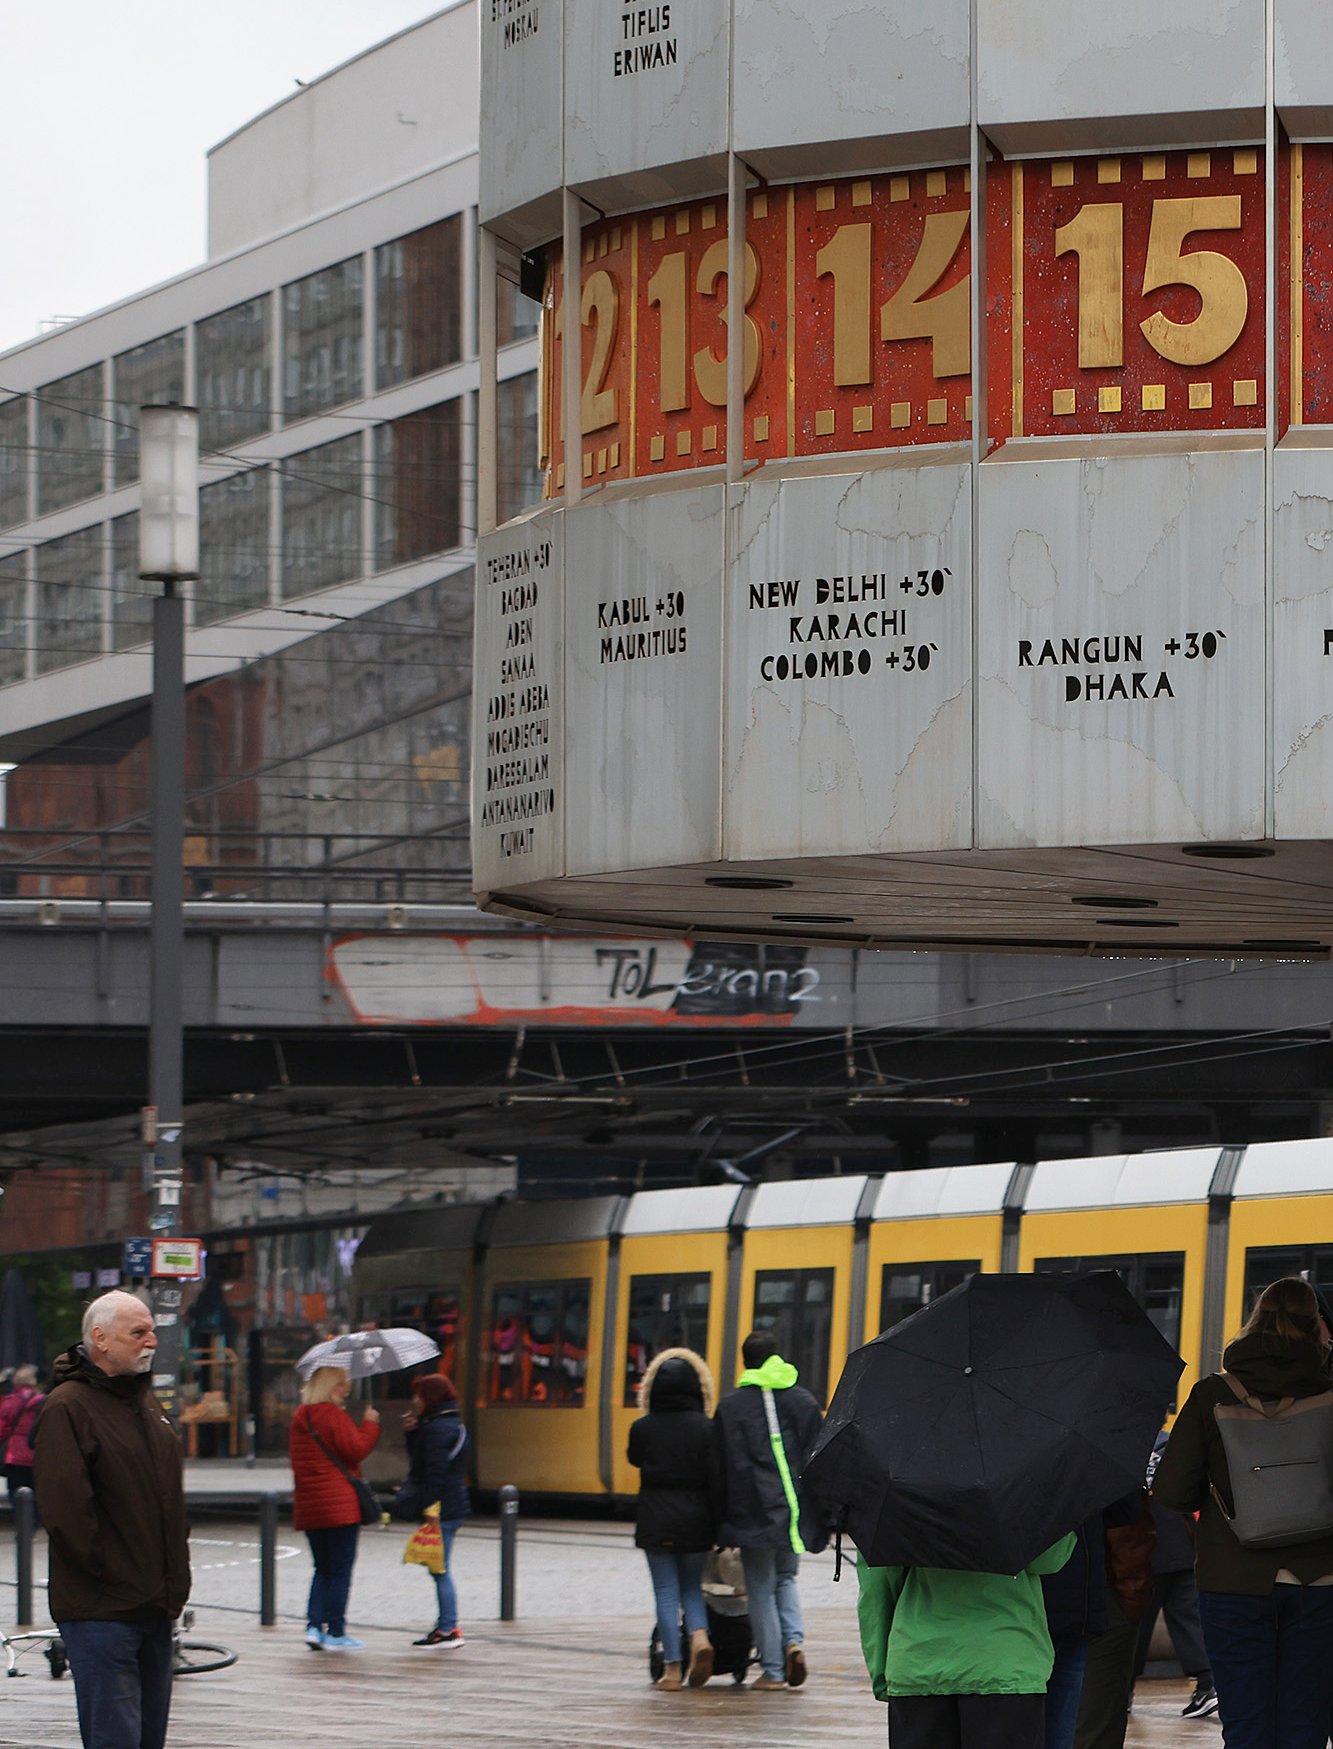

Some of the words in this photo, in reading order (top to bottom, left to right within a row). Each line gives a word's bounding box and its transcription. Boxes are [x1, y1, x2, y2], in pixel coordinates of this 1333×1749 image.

[504, 8, 539, 49] MOSKAU
[622, 5, 670, 39] TIFLIS
[614, 39, 676, 76] ERIWAN
[815, 209, 970, 386] 14
[1054, 195, 1248, 368] 15
[647, 238, 760, 413] 13
[487, 555, 530, 584] TEHERAN
[501, 582, 538, 616] BAGDAD
[749, 580, 800, 609] NEW
[816, 574, 886, 604] DELHI
[598, 597, 650, 628] KABUL
[656, 591, 684, 618] +30
[790, 609, 906, 643] KARACHI
[506, 618, 533, 649] ADEN
[601, 627, 686, 663] MAURITIUS
[1018, 635, 1142, 666] RANGUN
[501, 652, 536, 684] SANAA
[761, 649, 871, 681] COLOMBO
[487, 690, 515, 723] ADDIS
[518, 684, 550, 715] ABEBA
[1065, 672, 1175, 702] DHAKA
[487, 719, 549, 756] MOGADISCHU
[487, 755, 549, 791] DARESSALAM
[481, 788, 554, 827] ANTANANARIVO
[500, 828, 534, 857] KUWAIT
